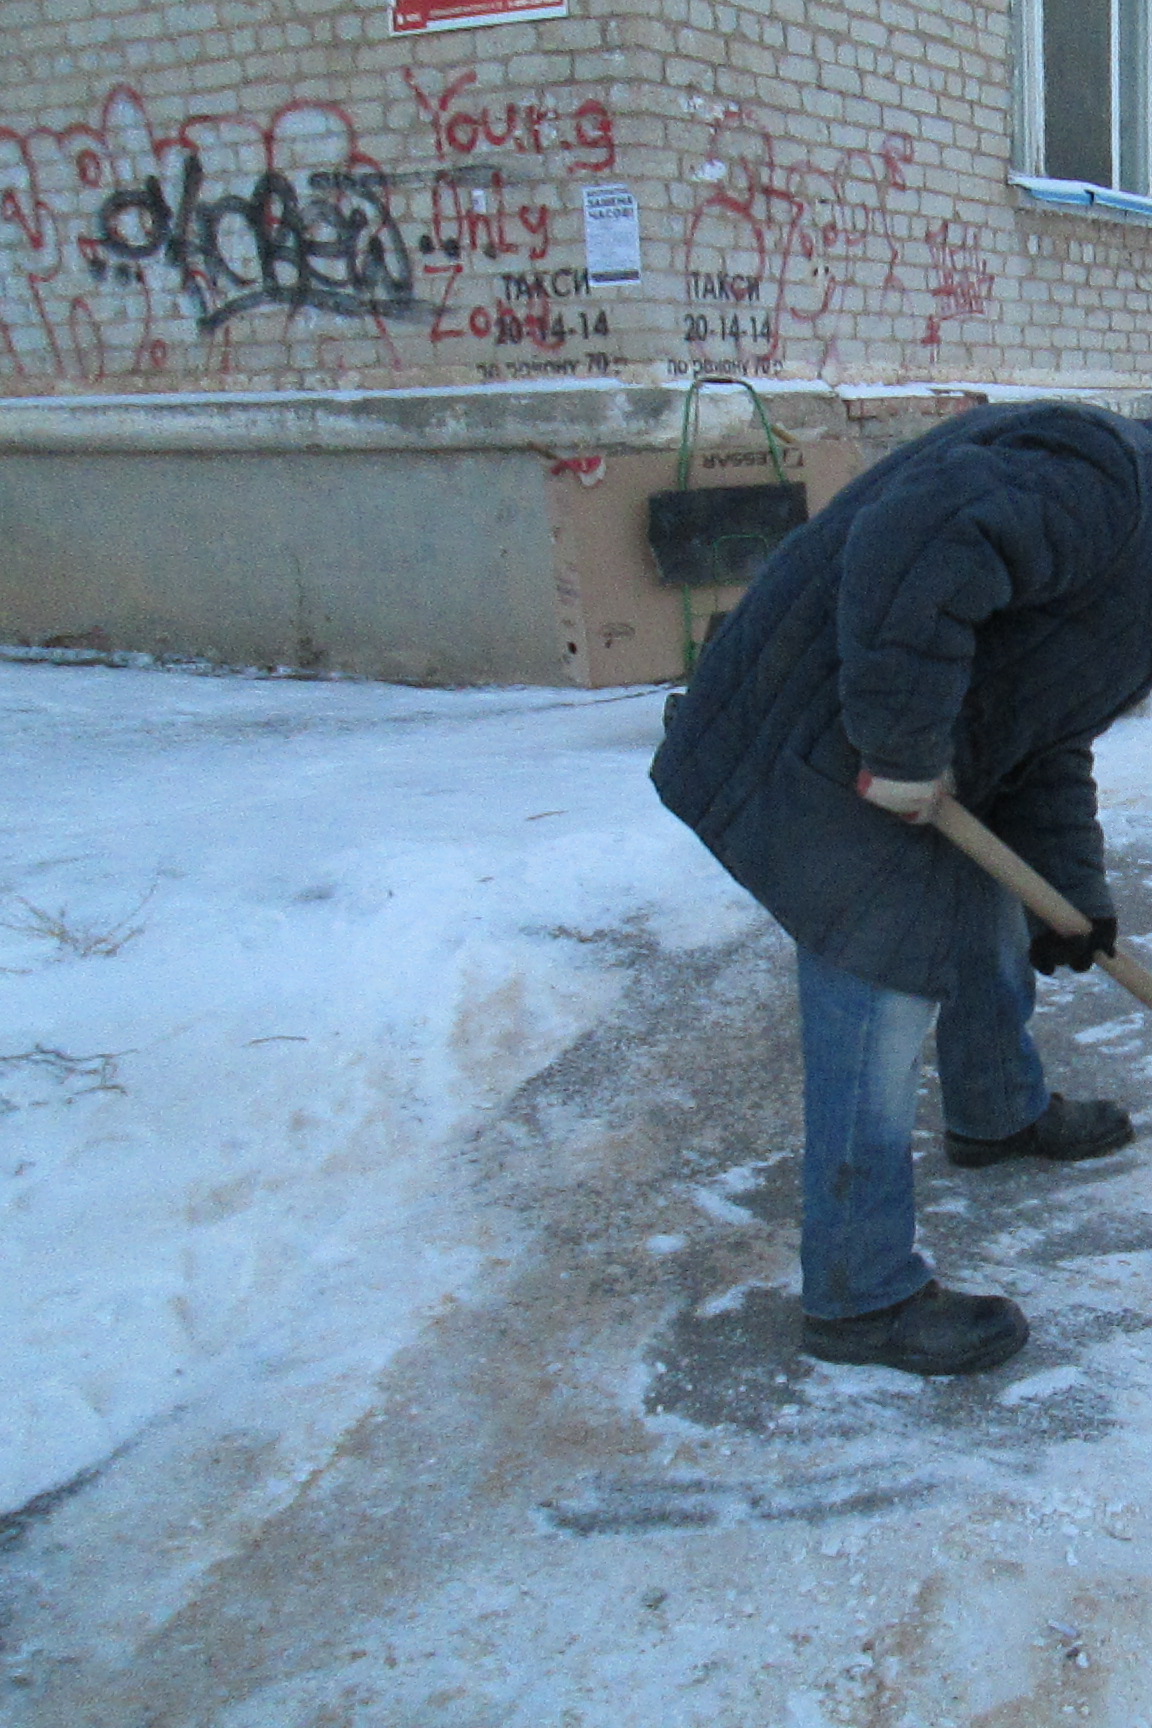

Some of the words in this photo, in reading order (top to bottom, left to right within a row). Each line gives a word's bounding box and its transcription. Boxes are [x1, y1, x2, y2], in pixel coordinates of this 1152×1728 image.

[690, 270, 760, 301] ТАКСИ
[685, 312, 771, 344] 20-14-14
[702, 450, 776, 469] ESSAR
